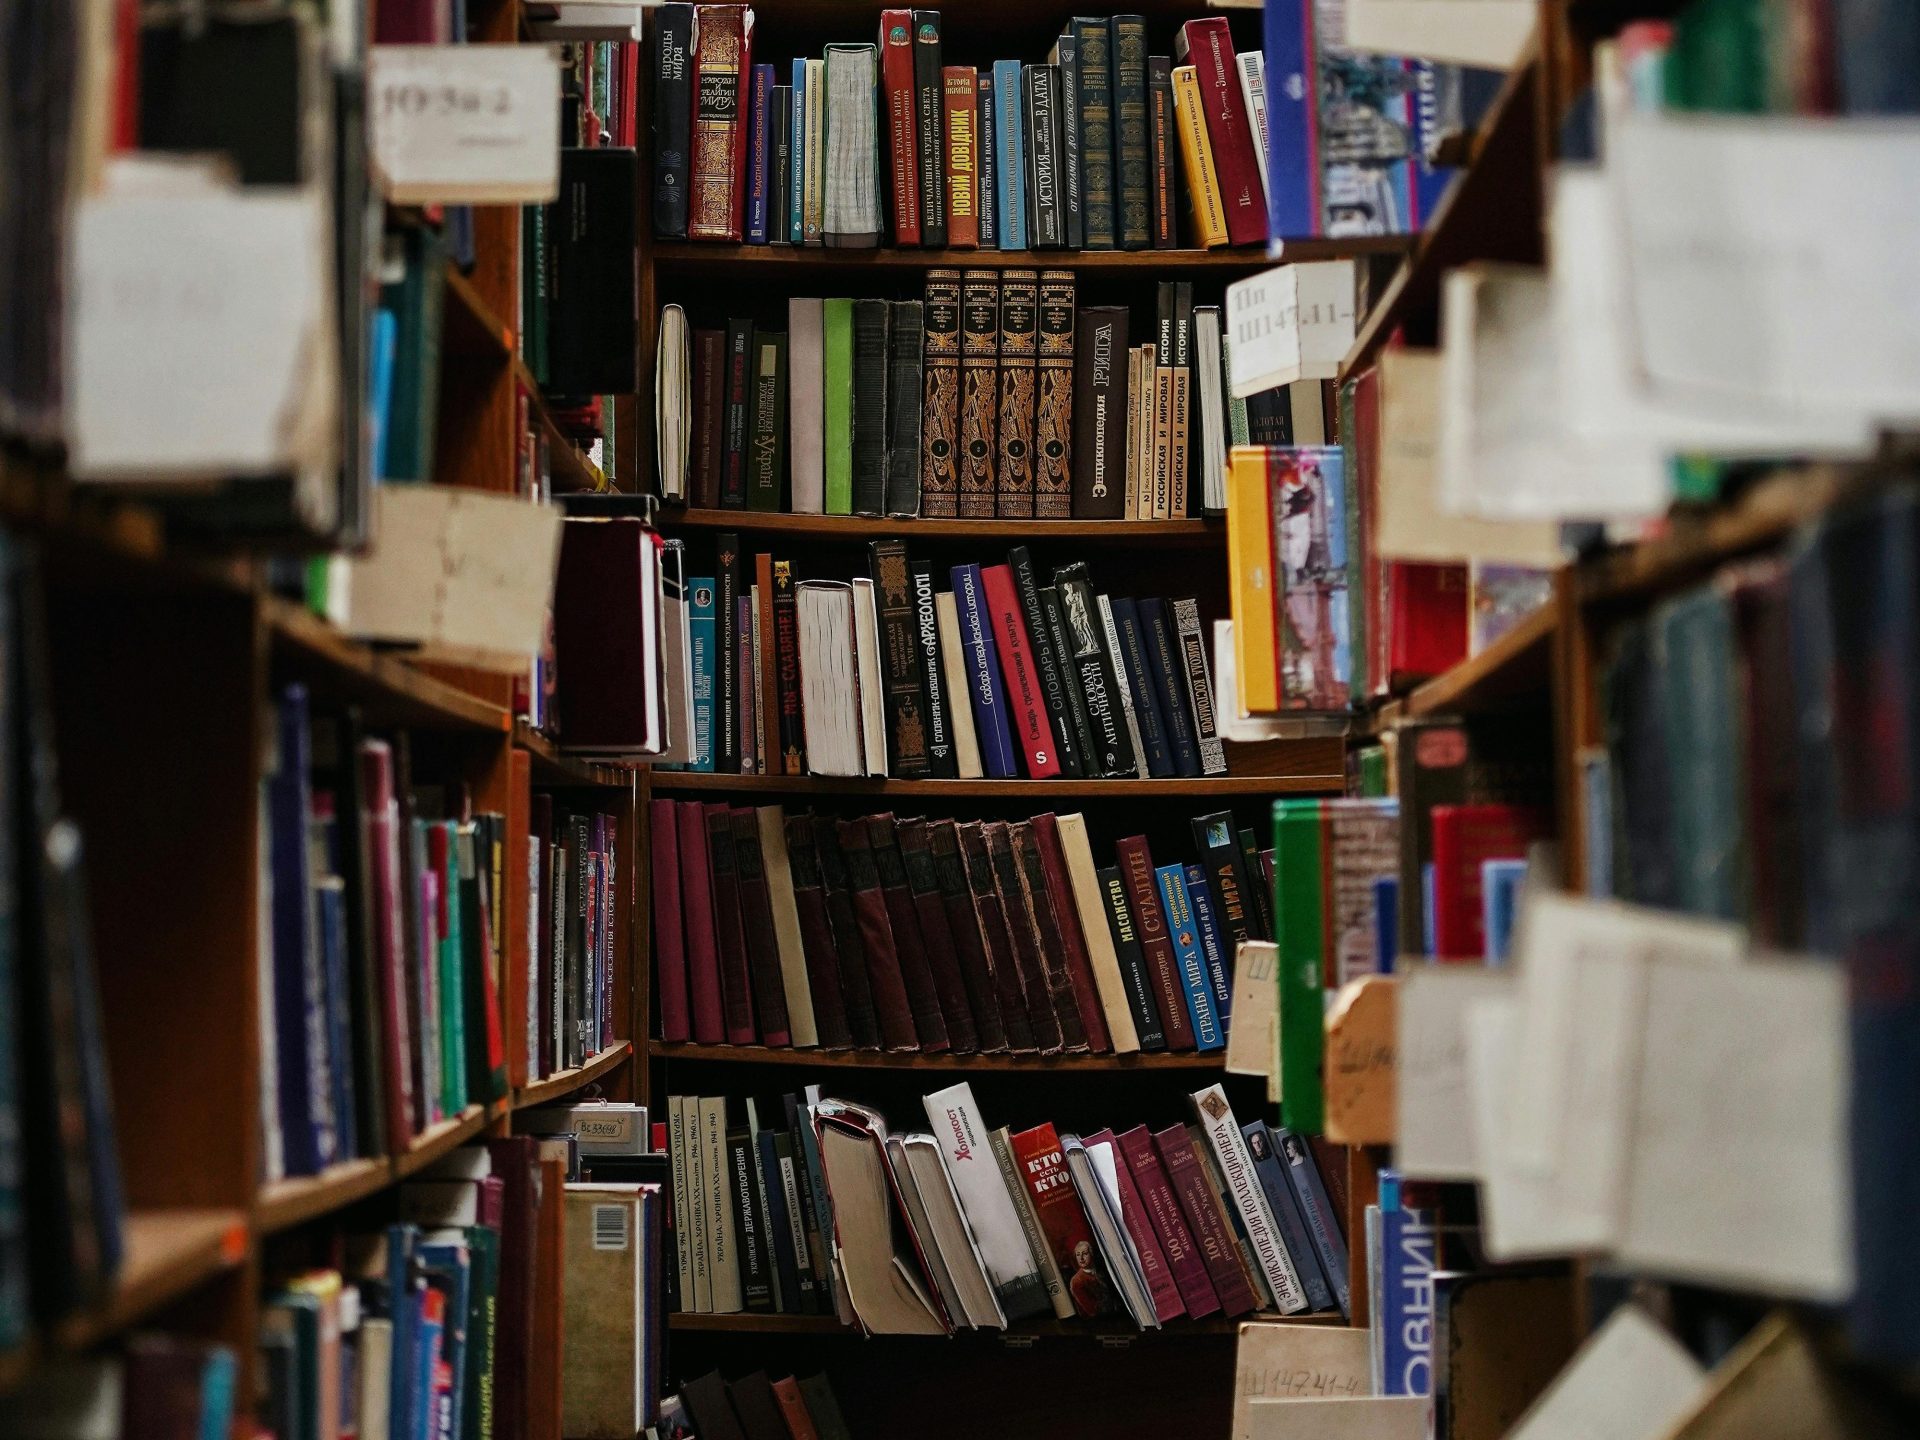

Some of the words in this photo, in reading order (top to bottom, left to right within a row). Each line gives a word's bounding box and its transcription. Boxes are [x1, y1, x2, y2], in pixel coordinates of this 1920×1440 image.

[661, 30, 680, 79] народы
[670, 46, 684, 81] мира
[700, 77, 736, 85] НАРОДЫ
[754, 71, 767, 109] України
[1034, 71, 1050, 108] ДАТАХ
[700, 95, 736, 110] МИРА
[893, 89, 903, 117] МИРА
[903, 89, 912, 139] СПРАВОЧНИК
[922, 86, 931, 117] СВЕТА
[931, 87, 941, 137] СПРАВОЧНИК
[1065, 70, 1076, 134] НЕБОСКРЕБОВ
[753, 109, 765, 163] особистості
[795, 106, 803, 154] СОВРЕМЕННОМ
[895, 120, 905, 155] ХРАМЫ
[922, 119, 933, 155] ЧУДЕСА
[951, 108, 974, 171] ДОВІДНИК
[984, 120, 992, 156] НАРОДОВ
[1068, 135, 1077, 150] ДО
[1194, 126, 1205, 155] КУЛЬТУРЕ
[751, 164, 764, 197] Видатні
[905, 139, 916, 229] ЭНЦИКЛОПЕДИЧЕСКИЙ
[933, 139, 943, 227] ЭНЦИКЛОПЕДИЧЕСКИЙ
[985, 164, 993, 188] СТРАН
[1037, 154, 1053, 207] ИСТОРИЯ
[1068, 154, 1078, 198] ПИРАМИД
[1198, 156, 1210, 185] МИРОВОЙ
[1204, 184, 1211, 193] ПО
[896, 158, 908, 229] ВЕЛИЧАЙШИЕ
[924, 157, 935, 226] ВЕЛИЧАЙШИЕ
[947, 174, 971, 217] НОВИЙ
[1070, 201, 1078, 213] ОТ
[1206, 195, 1219, 233] СПРАВОЧНИК
[1092, 323, 1112, 387] РИГА
[1160, 319, 1170, 365] ИСТОРИЯ
[1177, 319, 1187, 365] ИСТОРИЯ
[764, 376, 776, 433] ПРОВІДНИКИ
[1159, 376, 1168, 424] МИРОВАЯ
[1176, 376, 1186, 424] МИРОВАЯ
[1092, 394, 1108, 498] Энциклопедия
[1128, 424, 1136, 460] Справочник
[1144, 420, 1152, 456] Справочник
[754, 436, 776, 489] Україні
[1157, 445, 1167, 511] РОССИЙСКАЯ
[1173, 445, 1184, 511] РОССИЙСКАЯ
[723, 573, 732, 648] ГОСУДАРСТВЕННОСТИ
[963, 573, 978, 614] истории
[1018, 560, 1047, 644] НУМИЗМАТА
[694, 636, 705, 657] МИРА
[778, 608, 796, 681] СЛАВЯНЕ!
[887, 623, 901, 678] СЛАВЯНСКАЯ
[966, 613, 987, 672] американской
[1004, 612, 1022, 649] культуры
[1051, 624, 1068, 664] НАЗВАНИЙ
[1123, 618, 1144, 675] ИСТОРИЧЕСКИЙ
[1152, 617, 1172, 674] ИСТОРИЧЕСКИЙ
[694, 658, 704, 689] МОНАРХИ
[723, 650, 732, 697] РОССИЙСКОЙ
[906, 646, 915, 664] XVII
[1186, 639, 1204, 677] МИКОЛА
[702, 675, 712, 700] РОССИЯ
[978, 670, 994, 705] Словарь
[1012, 650, 1032, 706] средневековой
[1040, 646, 1063, 710] СЛОВАРЬ
[1080, 662, 1099, 716] СЛОВАРЬ
[1138, 676, 1150, 708] СЛОВАРЬ
[1167, 676, 1179, 708] СЛОВАРЬ
[782, 689, 799, 716] МЫ
[903, 695, 911, 706] 2
[1090, 661, 1118, 745] АНТИЧНОСТИ
[1191, 679, 1215, 733] КОСТОМАРОВ
[691, 704, 711, 764] Энциклопедия
[724, 699, 733, 757] ЭНЦИКЛОПЕДИЯ
[1025, 708, 1040, 740] Словарь
[1036, 750, 1047, 765] S
[607, 890, 616, 928] ІСТОРІЯ
[1108, 879, 1134, 943] МАСОНСТВО
[1127, 850, 1160, 933] СТАЛИН
[1162, 871, 1182, 930] современный
[1173, 874, 1190, 923] справочник
[1199, 902, 1209, 914] до
[1218, 863, 1245, 921] МИРА
[606, 930, 615, 984] ВСЕСВІТНЯ
[1204, 933, 1220, 963] МИРА
[1183, 950, 1203, 988] МИРА
[1211, 961, 1229, 1001] СТРАНЫ
[1156, 950, 1181, 1029] ЭНЦИКЛОПЕДИЯ
[1192, 990, 1216, 1044] СТРАНЫ
[958, 1106, 977, 1148] энциклопедия
[674, 1152, 684, 1190] ХРОНІКА
[712, 1172, 721, 1186] XX
[785, 1169, 793, 1180] XX
[1027, 1151, 1062, 1174] КТО
[1039, 1166, 1059, 1178] есть
[1136, 1154, 1157, 1168] ШАРОВ
[1172, 1153, 1194, 1167] ШАРОВ
[1214, 1123, 1258, 1215] КОЛЛЕКЦИОНЕРА
[676, 1189, 684, 1202] XX
[693, 1187, 702, 1201] XX
[735, 1146, 755, 1234] ДЕРЖАВОТВОРЕННЯ
[787, 1180, 799, 1218] ІСТОРИКИ
[1034, 1171, 1070, 1194] КТО
[1193, 1176, 1211, 1210] Україну
[694, 1200, 704, 1238] ХРОНІКА
[713, 1185, 723, 1223] ХРОНІКА
[1149, 1188, 1172, 1239] видатних
[1159, 1185, 1180, 1226] України
[1207, 1208, 1218, 1227] про
[747, 1234, 760, 1276] УКРАЇНСЬКЕ
[793, 1220, 806, 1265] УКРАЇНСЬКІ
[1167, 1238, 1186, 1263] 100
[1177, 1226, 1192, 1252] місць
[1203, 1236, 1222, 1261] 100
[1249, 1214, 1292, 1302] ЭНЦИКЛОПЕДИЯ
[1142, 1250, 1159, 1271] 100
